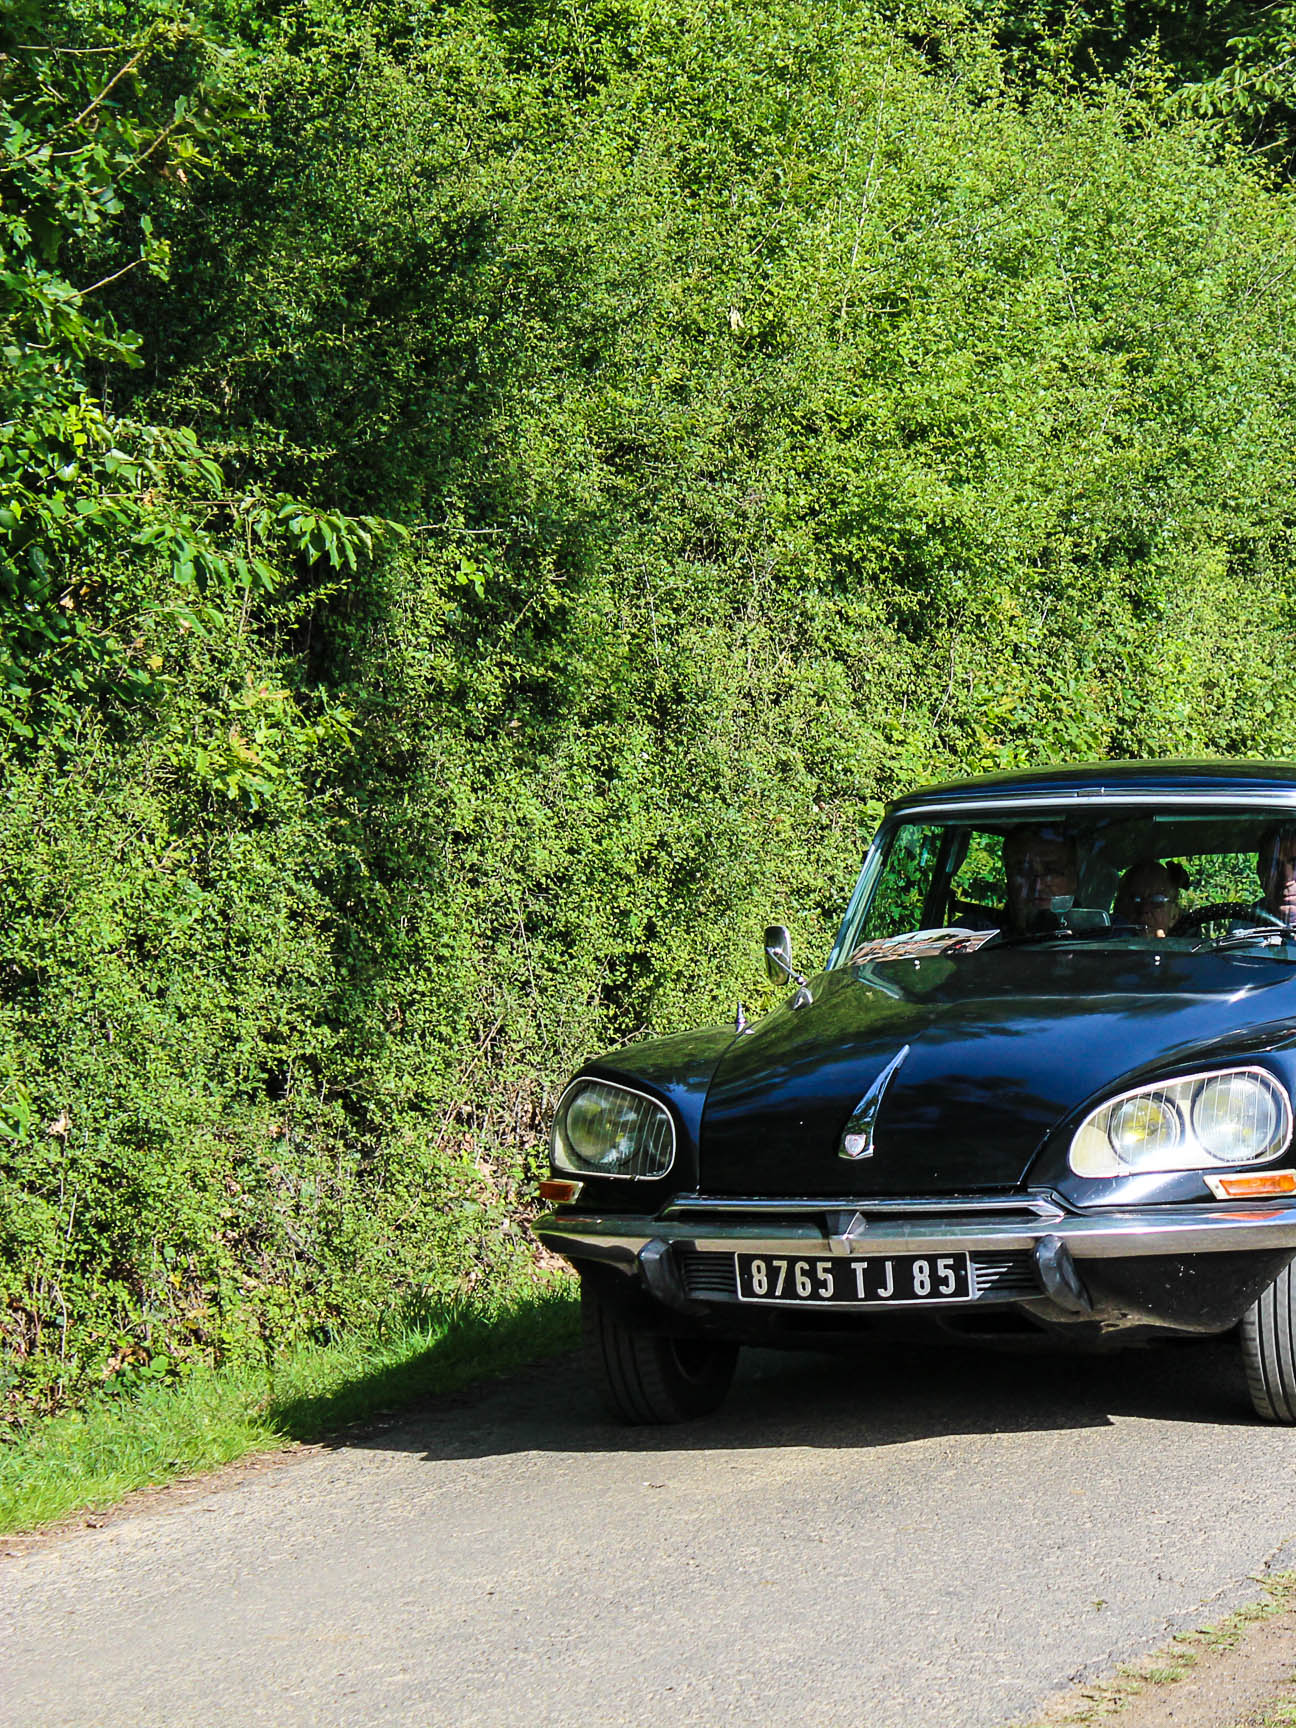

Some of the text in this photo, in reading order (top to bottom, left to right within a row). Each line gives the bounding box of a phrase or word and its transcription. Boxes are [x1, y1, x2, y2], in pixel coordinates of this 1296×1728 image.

[751, 1258, 956, 1298] 8765 TJ 85
